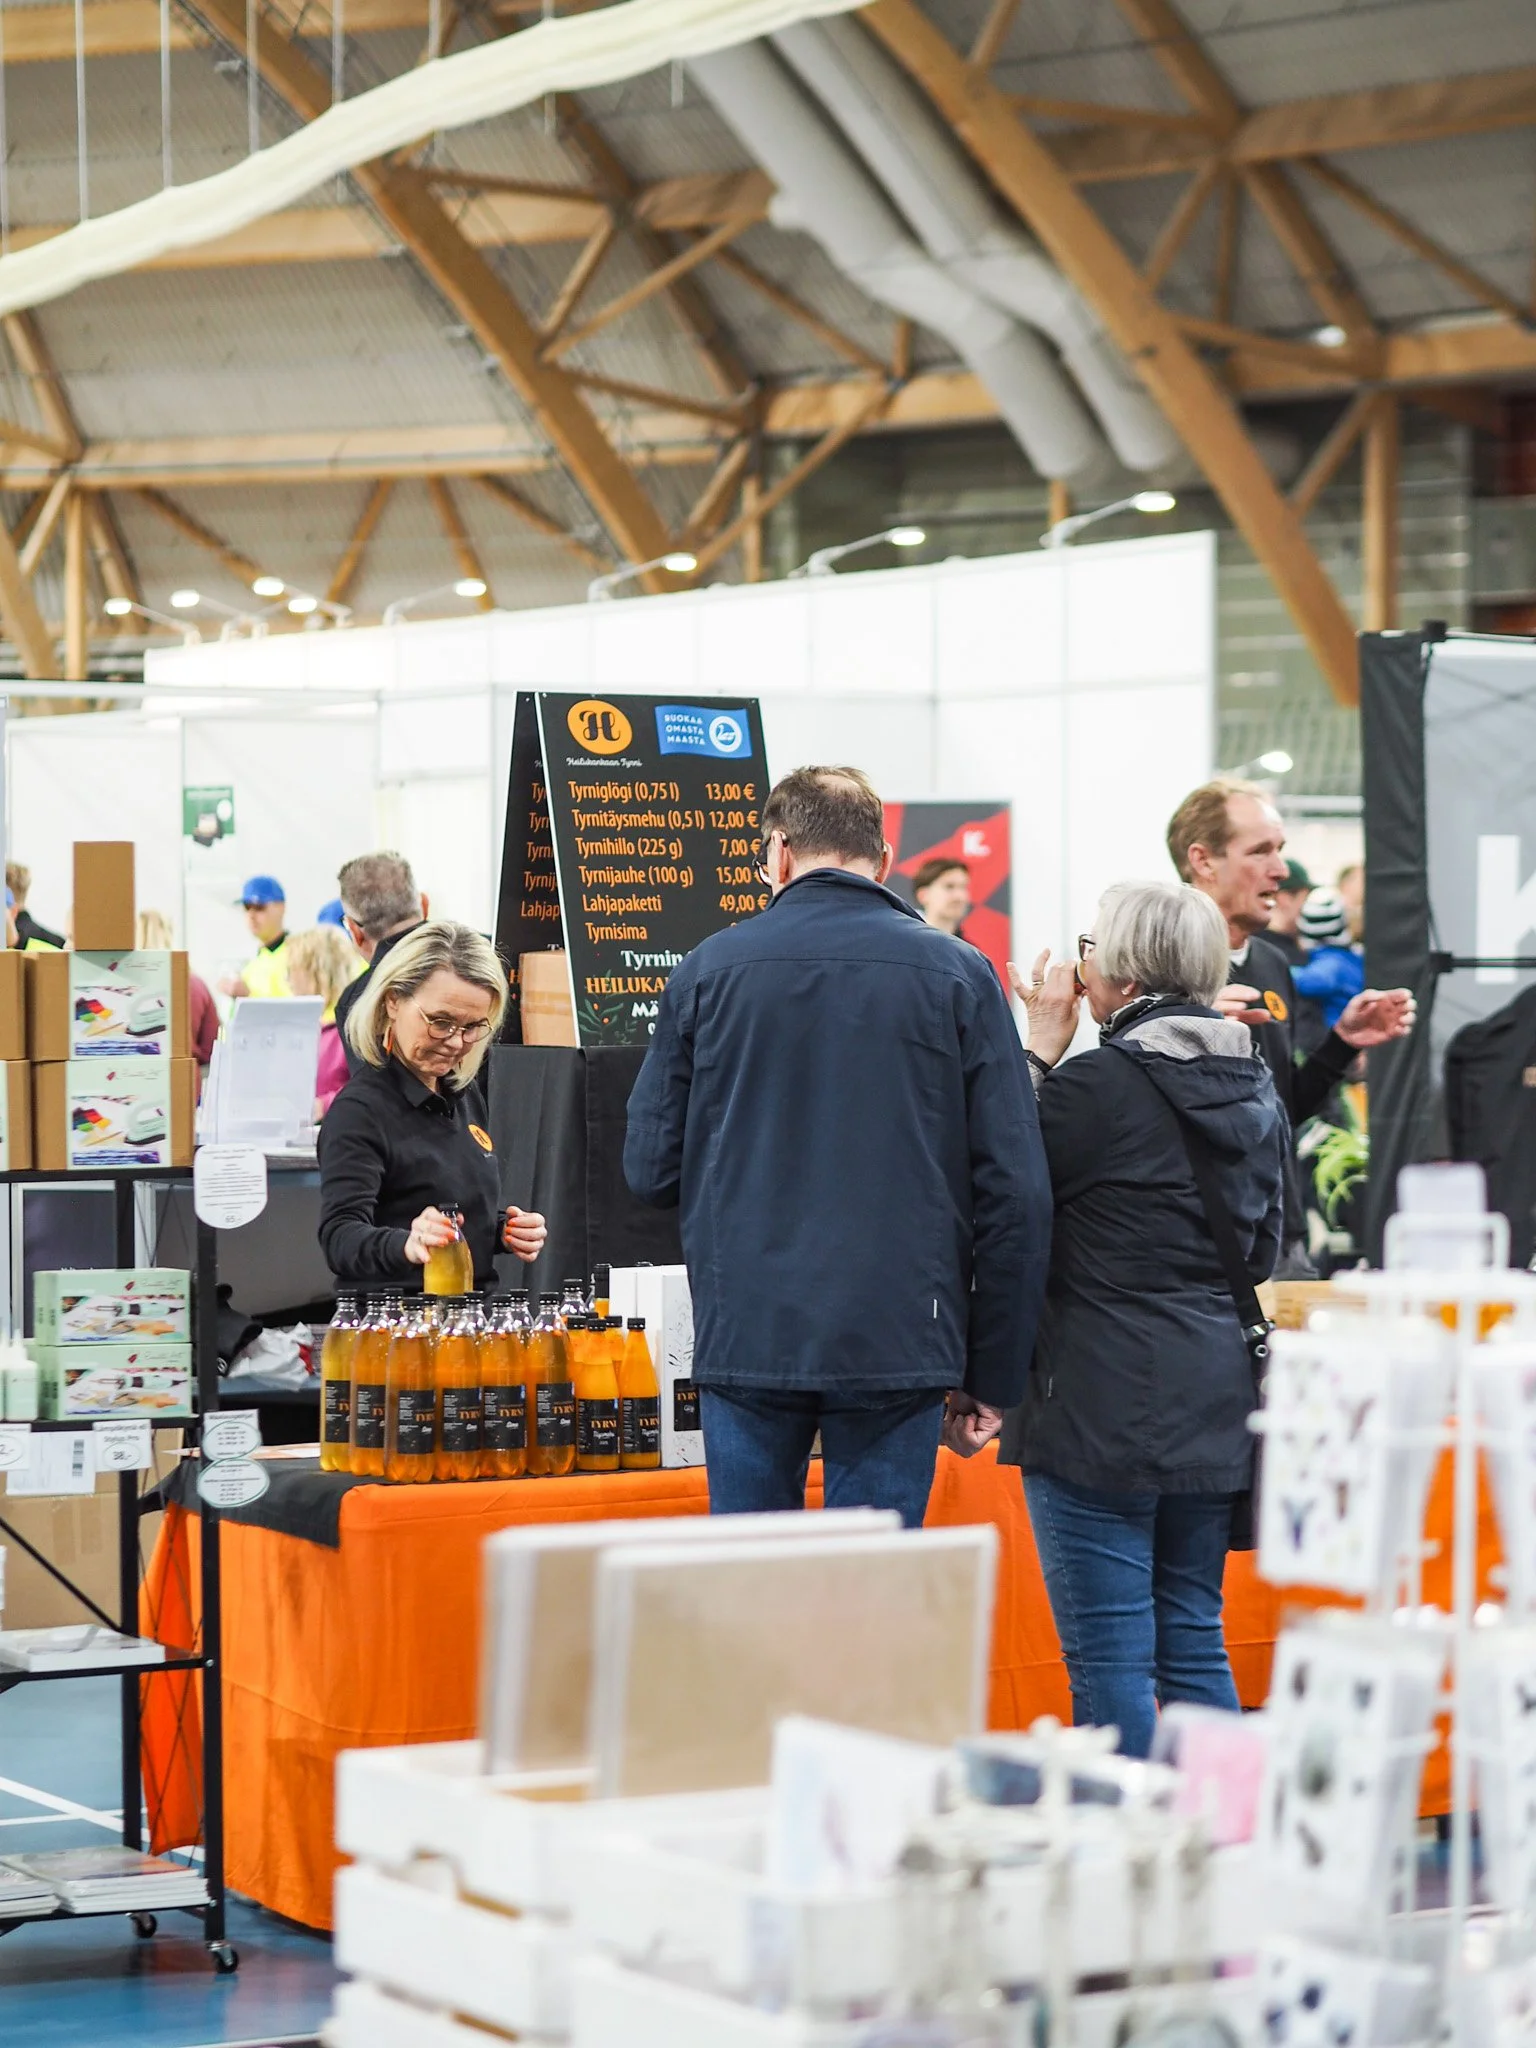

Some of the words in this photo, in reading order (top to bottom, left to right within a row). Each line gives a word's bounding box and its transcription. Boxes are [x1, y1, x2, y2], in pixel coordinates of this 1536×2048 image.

[664, 714, 703, 724] RUOKAA
[665, 725, 704, 735] OMASTA
[667, 735, 706, 745] MAASTA
[568, 781, 632, 804] Tyrniglögi
[635, 782, 667, 802] (0,75
[705, 783, 741, 802] 13,00
[743, 783, 756, 801] €
[572, 808, 665, 831] Tyrnitäysmehu
[668, 810, 693, 829] (0,5
[709, 811, 744, 830] 12,00
[747, 811, 760, 828] €
[575, 837, 635, 859] Tyrnihillo
[637, 838, 666, 856] (225
[669, 838, 683, 859] g)
[719, 838, 748, 858] 7,00
[750, 838, 762, 856] €
[578, 865, 645, 888] Tyrnijauhe
[648, 866, 677, 885] (100
[679, 866, 694, 888] g)
[716, 866, 751, 885] 15,00
[582, 893, 662, 916] Lahjapaketti
[719, 894, 754, 913] 49,00
[757, 894, 769, 911] €
[585, 922, 648, 944] Tyrnisima
[585, 976, 669, 994] HEILUKA
